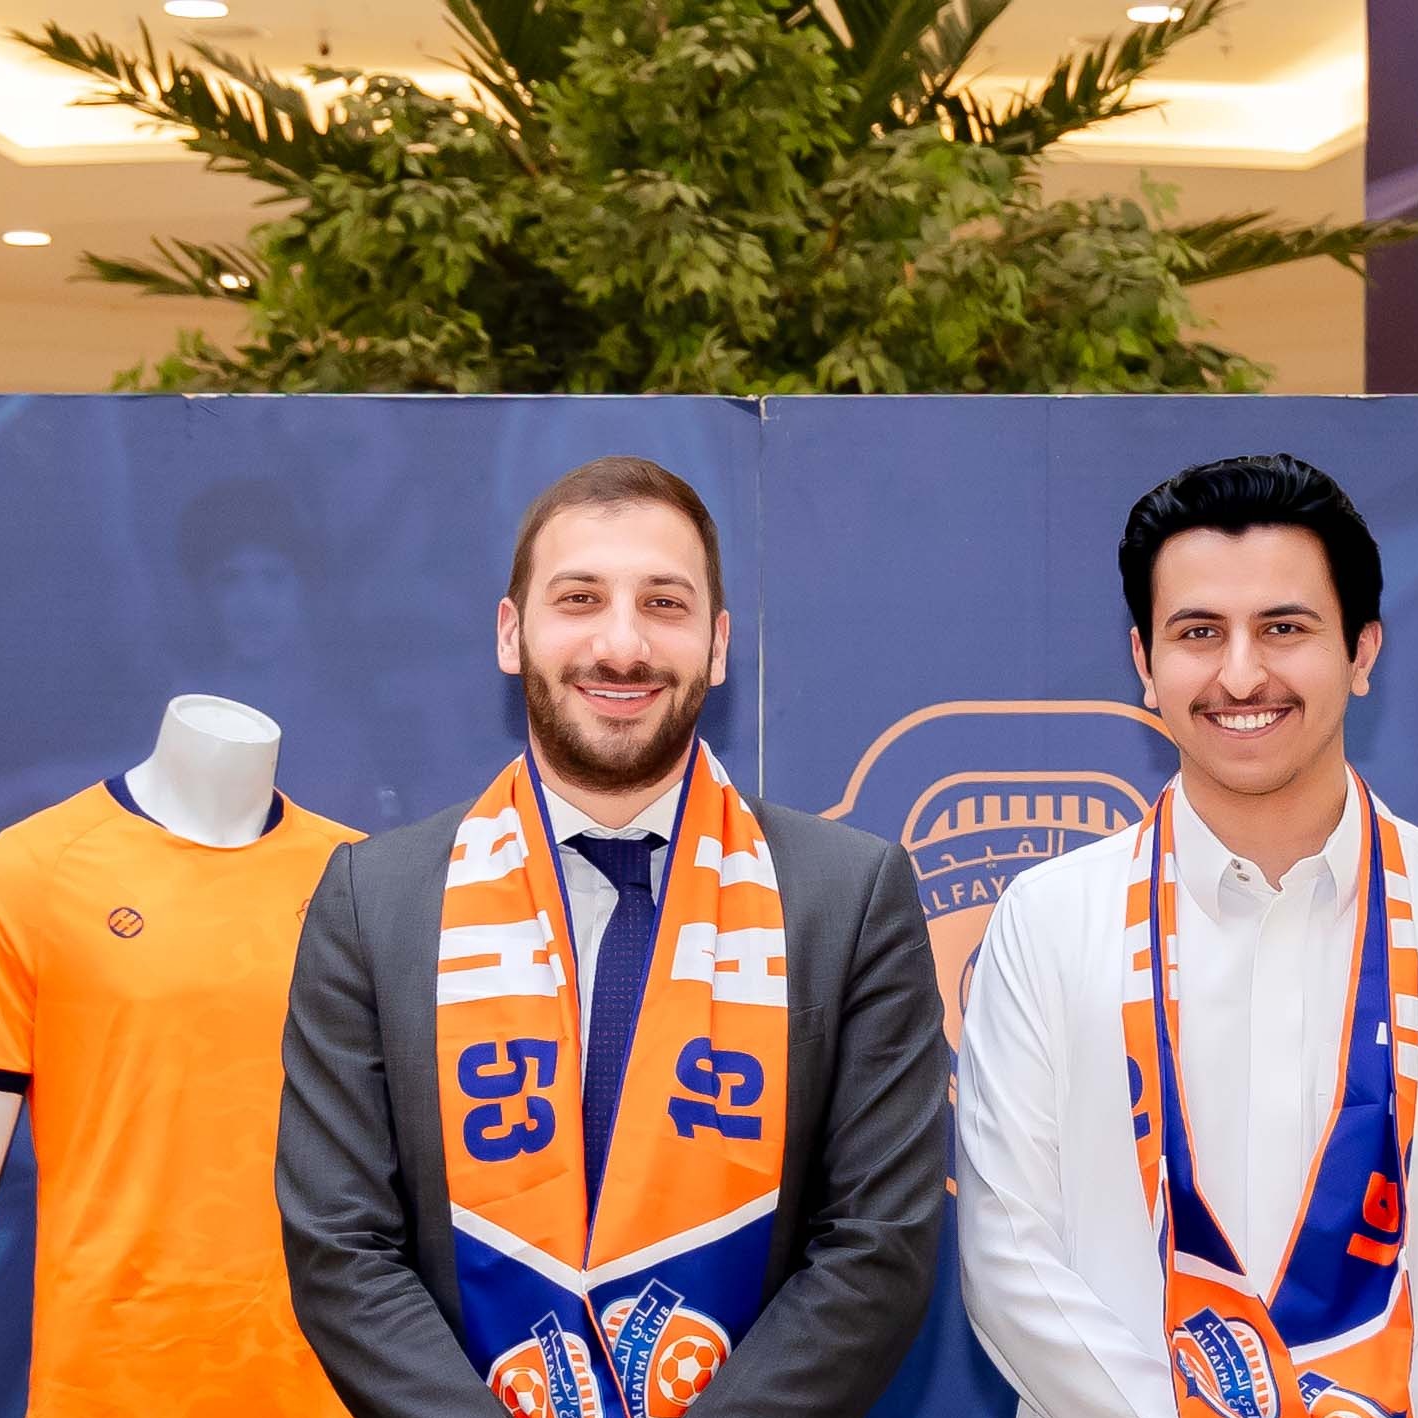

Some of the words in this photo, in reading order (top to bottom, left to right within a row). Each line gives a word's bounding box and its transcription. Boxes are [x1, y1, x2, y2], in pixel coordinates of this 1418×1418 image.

[910, 829, 1065, 881] الفيحا
[922, 874, 1019, 915] LFAY
[458, 1038, 558, 1162] 53
[668, 1037, 764, 1140] 19
[643, 1305, 670, 1344] CLUB
[541, 1336, 564, 1405] ALFAYHA
[1193, 1330, 1232, 1393] ALFAYHA
